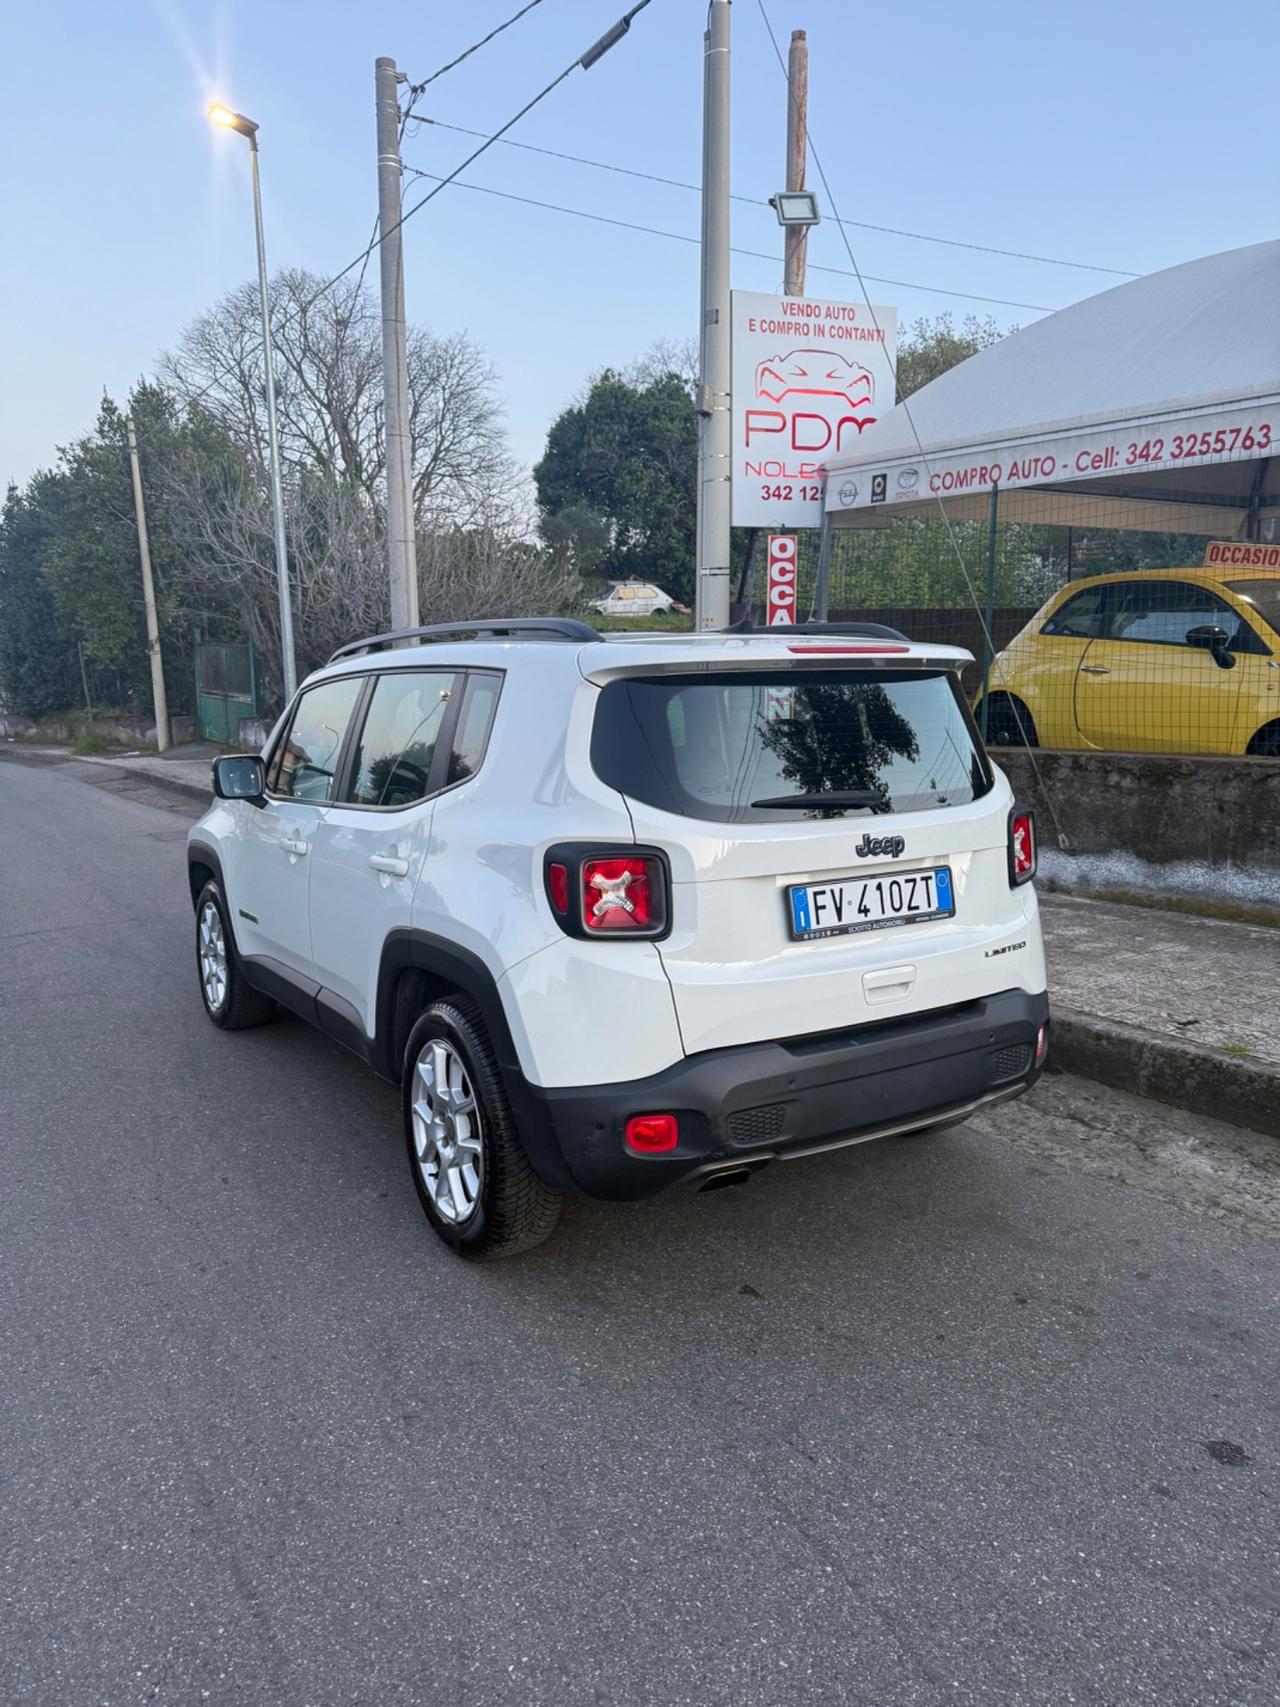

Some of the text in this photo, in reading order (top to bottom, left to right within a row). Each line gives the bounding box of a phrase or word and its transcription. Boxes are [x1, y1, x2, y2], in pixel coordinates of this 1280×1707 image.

[781, 302, 855, 321] VENDO AUTO
[749, 318, 885, 343] E COMPRO IN CONTANTI
[929, 463, 1002, 492] COMPRO
[1007, 456, 1056, 481] AUTO
[1075, 446, 1119, 472] Cell:
[1125, 438, 1165, 465] 342
[1170, 424, 1272, 460] 3255763
[761, 485, 793, 501] 342
[1209, 546, 1280, 566] OCCASIO
[855, 833, 906, 859] Jeep
[984, 940, 1027, 958] LIMITED
